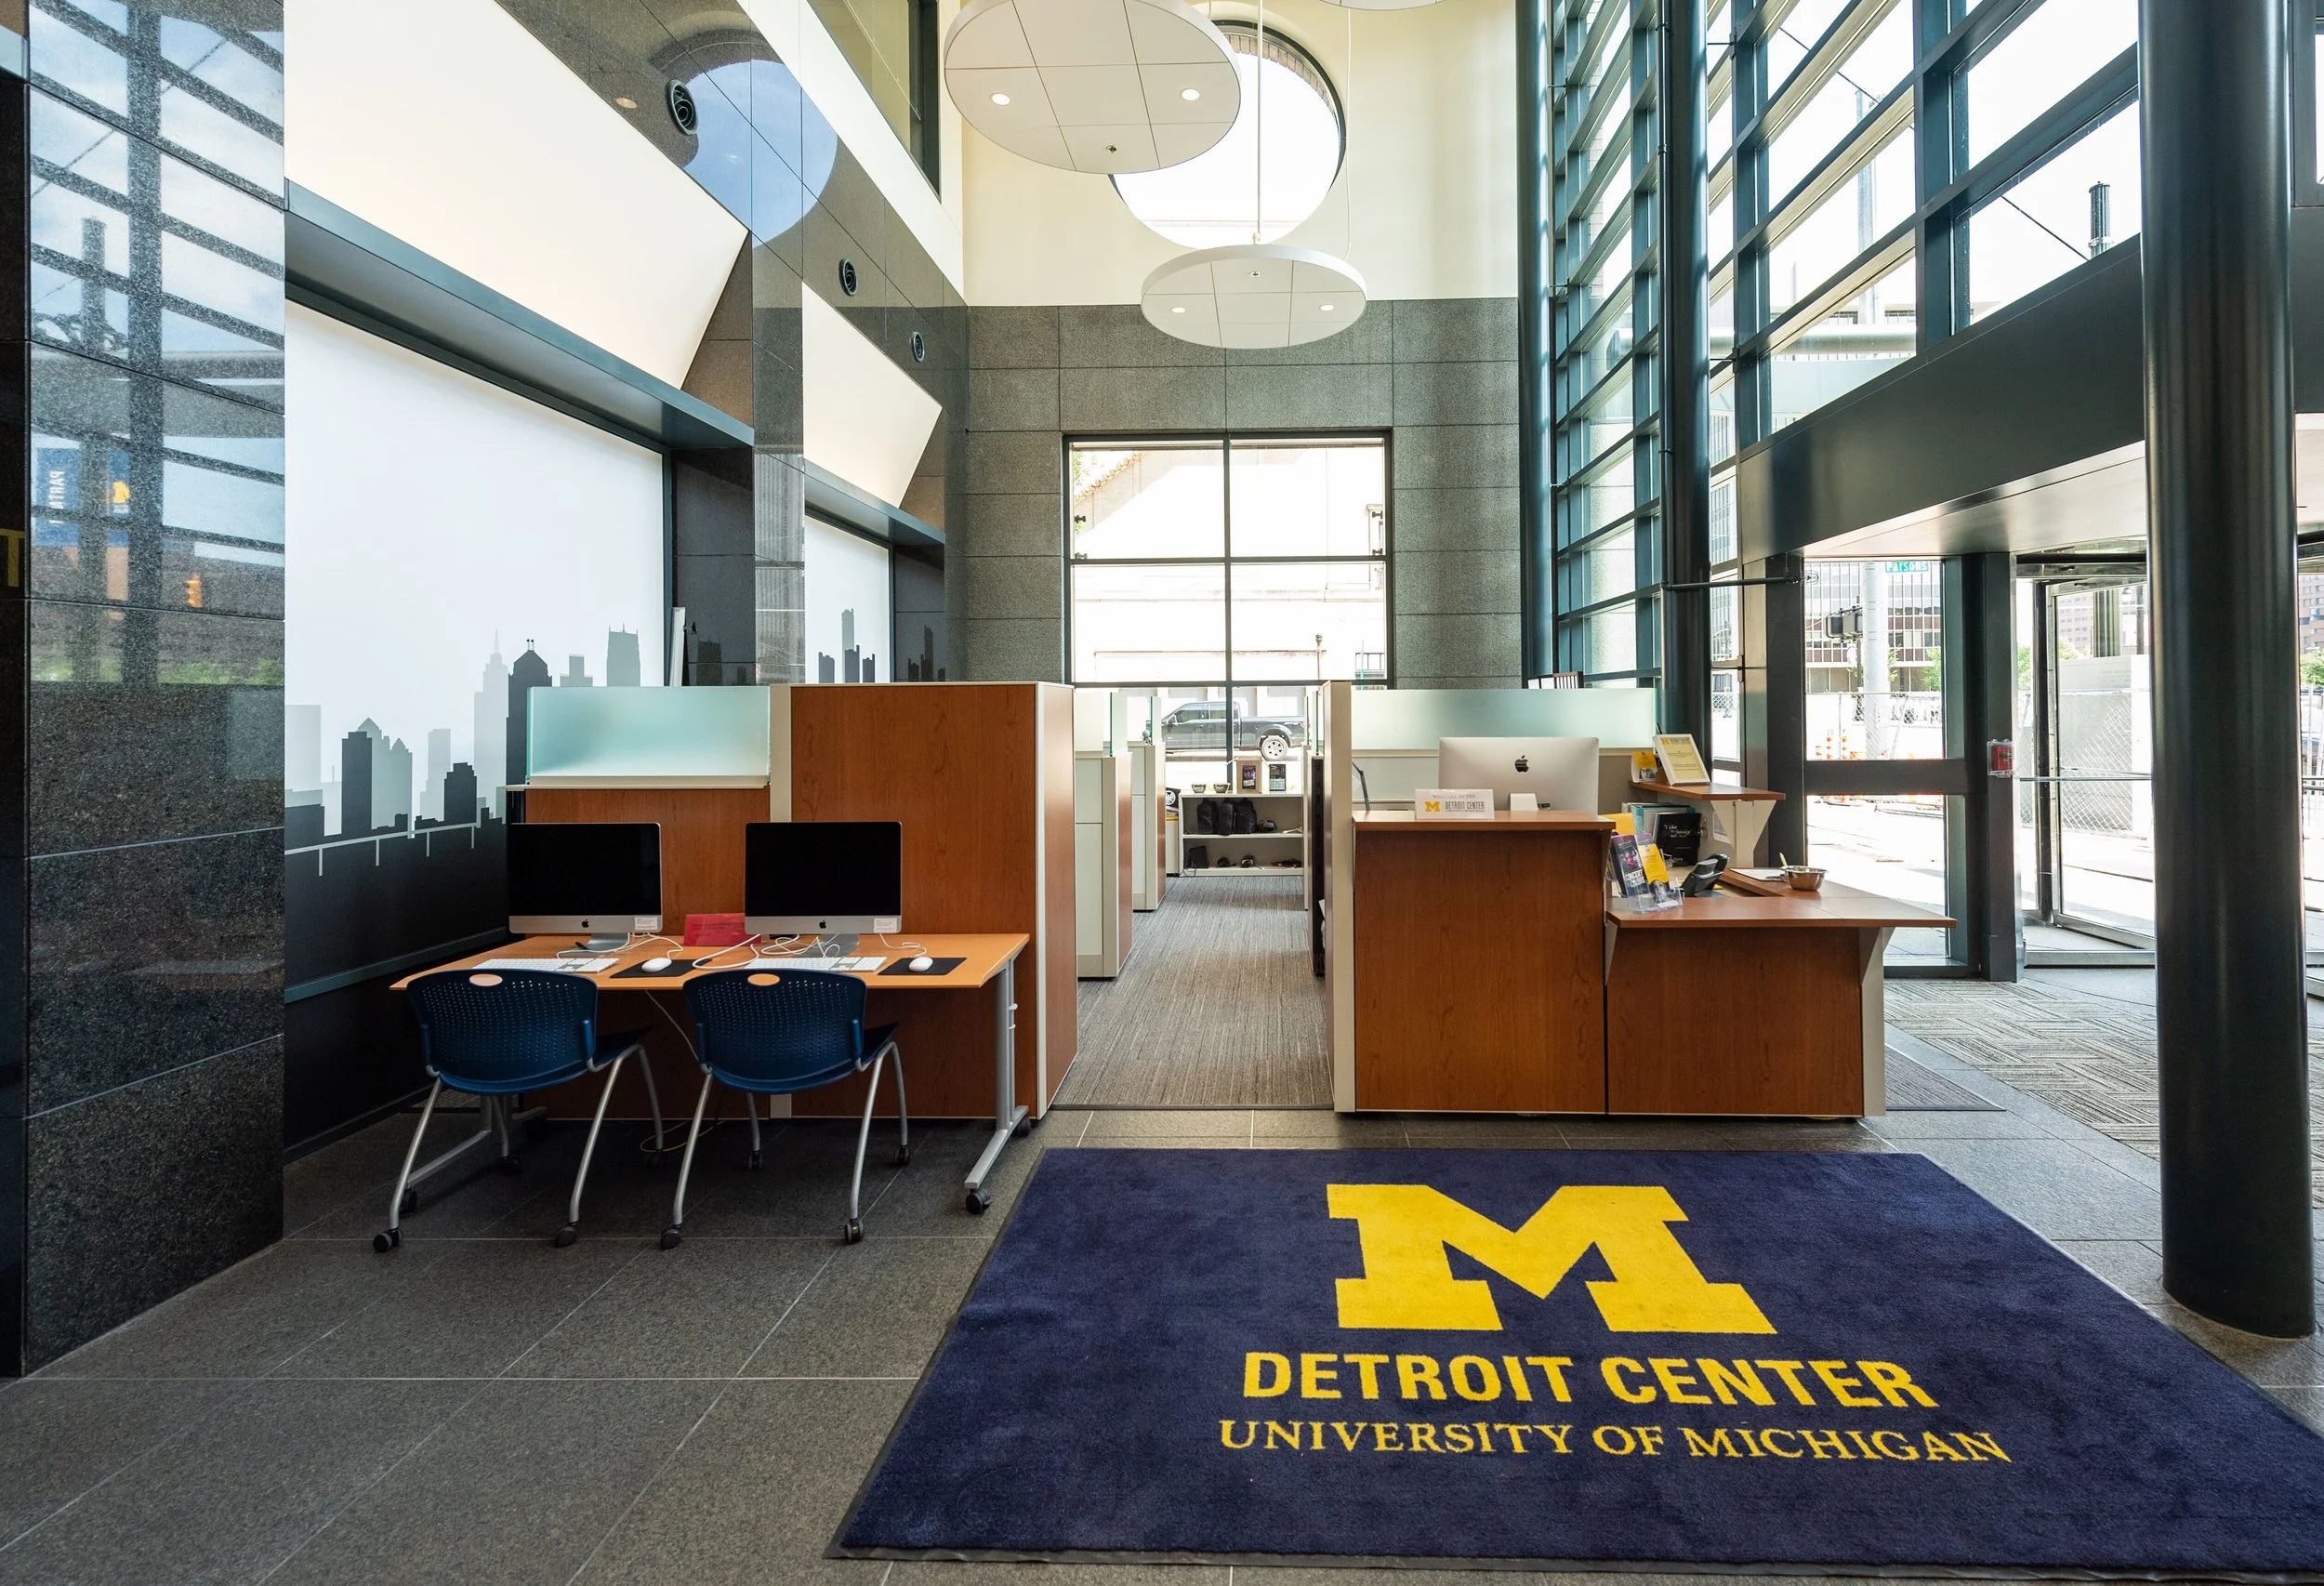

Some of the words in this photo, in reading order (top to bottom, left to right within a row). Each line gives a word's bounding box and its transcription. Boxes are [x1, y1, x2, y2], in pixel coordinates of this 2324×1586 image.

[1886, 561, 1928, 572] Parsons
[1425, 801, 1441, 812] M
[1446, 801, 1465, 810] DETROIT
[1467, 801, 1486, 810] CENTER
[1327, 1183, 1776, 1334] M
[1244, 1353, 1572, 1402] DETROIT
[1601, 1356, 1938, 1408] CENTER
[1220, 1420, 1573, 1455] UNIVERSITY
[1592, 1426, 1664, 1456] OF
[1679, 1427, 2011, 1462] MICHIGAN
